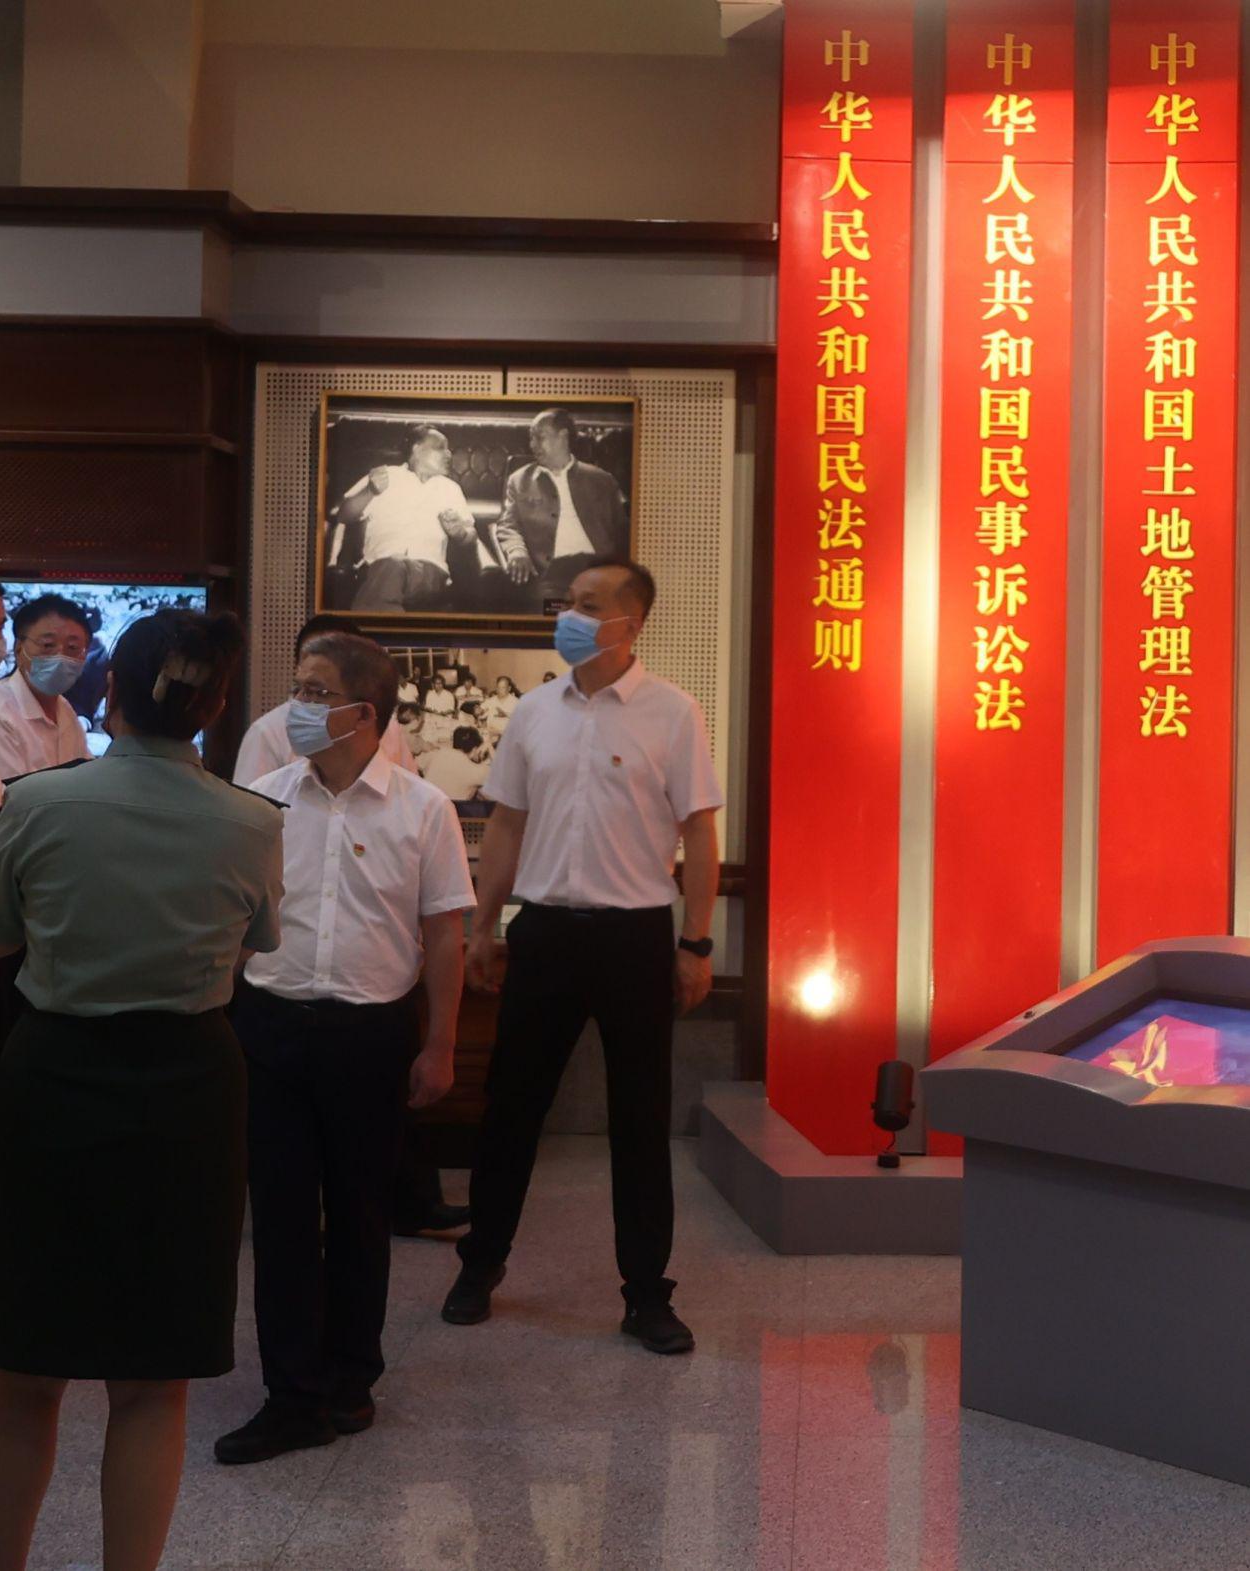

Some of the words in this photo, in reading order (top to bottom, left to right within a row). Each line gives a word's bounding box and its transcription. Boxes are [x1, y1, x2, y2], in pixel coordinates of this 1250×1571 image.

[811, 29, 874, 673] 中华人民共和国民法通则
[973, 33, 1038, 732] 中华人民共和国民事诉讼法
[1140, 33, 1200, 738] 中华人民共和国土地管理法
